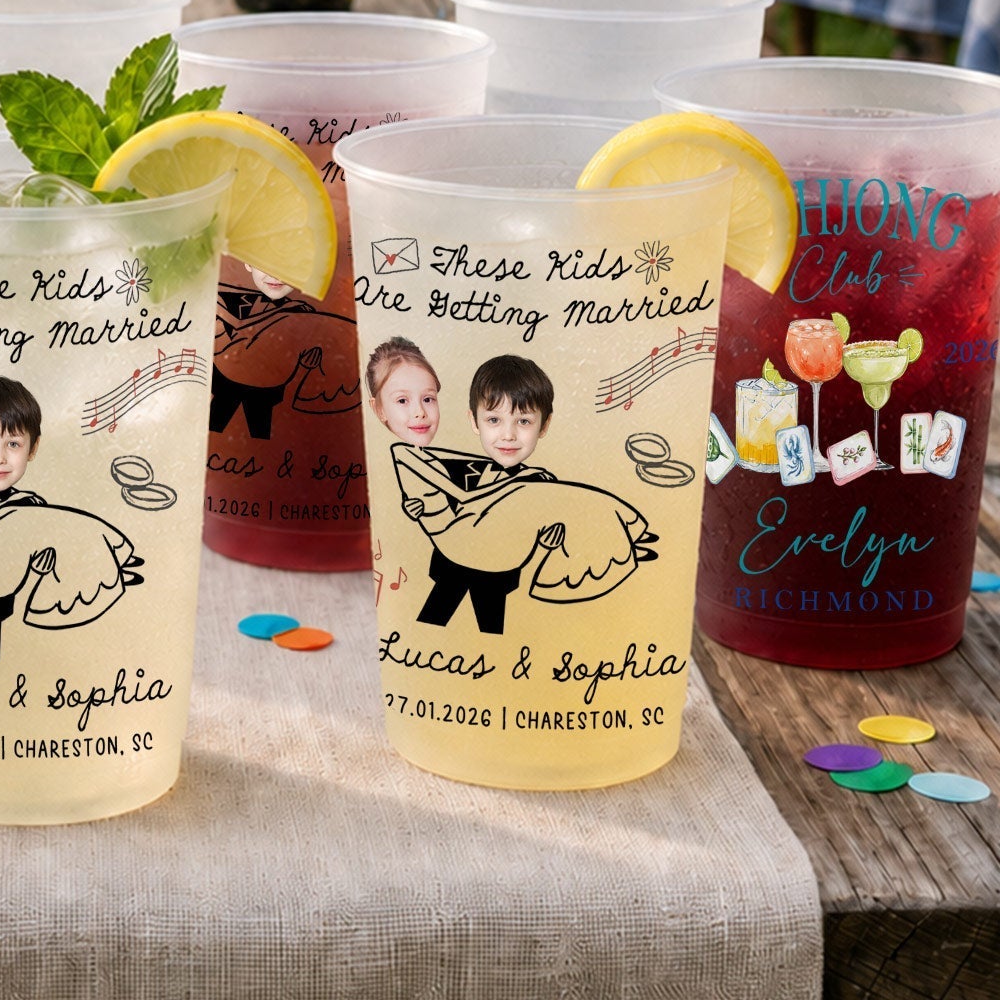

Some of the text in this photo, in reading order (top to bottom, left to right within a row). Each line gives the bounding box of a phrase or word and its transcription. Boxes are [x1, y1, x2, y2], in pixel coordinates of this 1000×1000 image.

[793, 177, 973, 251] HJONG
[31, 268, 114, 302] Kids
[430, 244, 633, 282] These Kids
[788, 244, 890, 304] Club
[47, 301, 192, 349] Married
[427, 288, 549, 343] Getting
[563, 279, 715, 328] Married
[944, 338, 999, 365] 2026
[206, 450, 367, 500] cas & Sop
[204, 496, 261, 518] 1.2026
[738, 496, 935, 588] Evelyn
[735, 586, 935, 613] RICHMOND
[378, 630, 687, 706] Lucas & Sophia
[8, 673, 28, 709] &
[47, 667, 173, 733] Sophia
[515, 707, 634, 731] CHARESTON,
[641, 706, 664, 727] SC
[13, 735, 126, 760] CHARESTON,
[132, 731, 153, 753] SC
